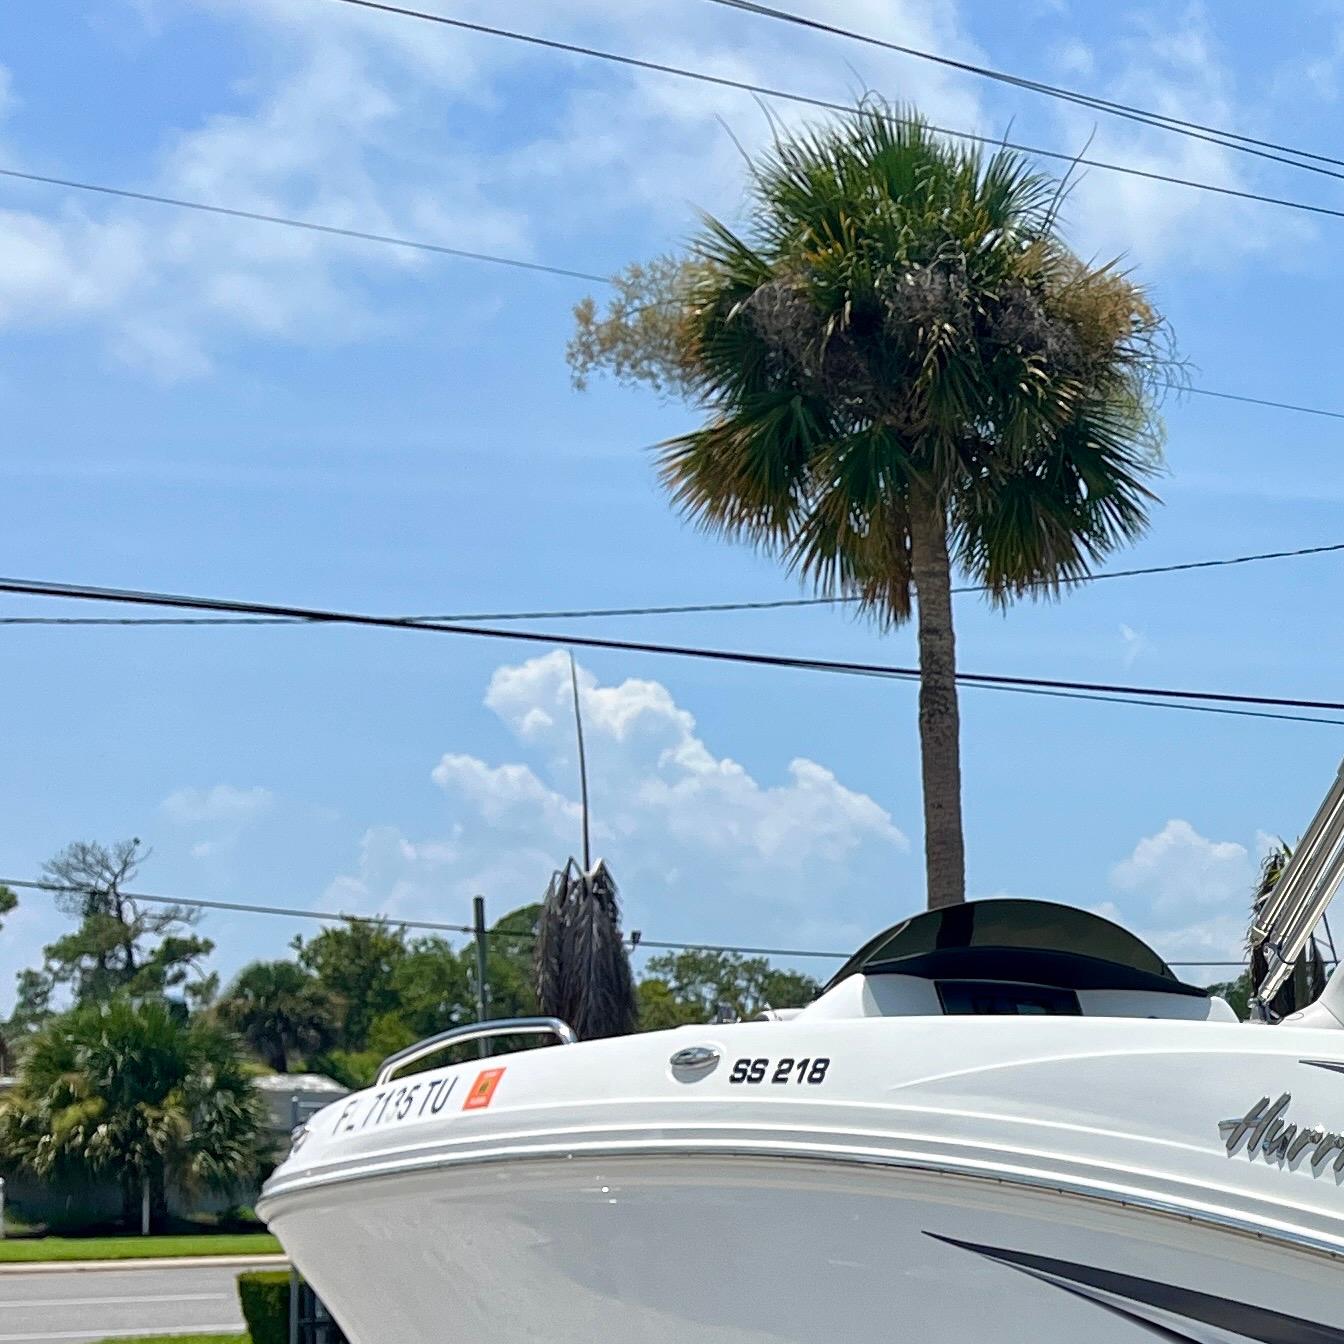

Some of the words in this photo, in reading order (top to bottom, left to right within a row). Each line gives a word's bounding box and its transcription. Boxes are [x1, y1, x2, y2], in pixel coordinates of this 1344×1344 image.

[729, 1058, 769, 1084] SS
[771, 1058, 830, 1084] 218
[418, 1076, 459, 1117] TU
